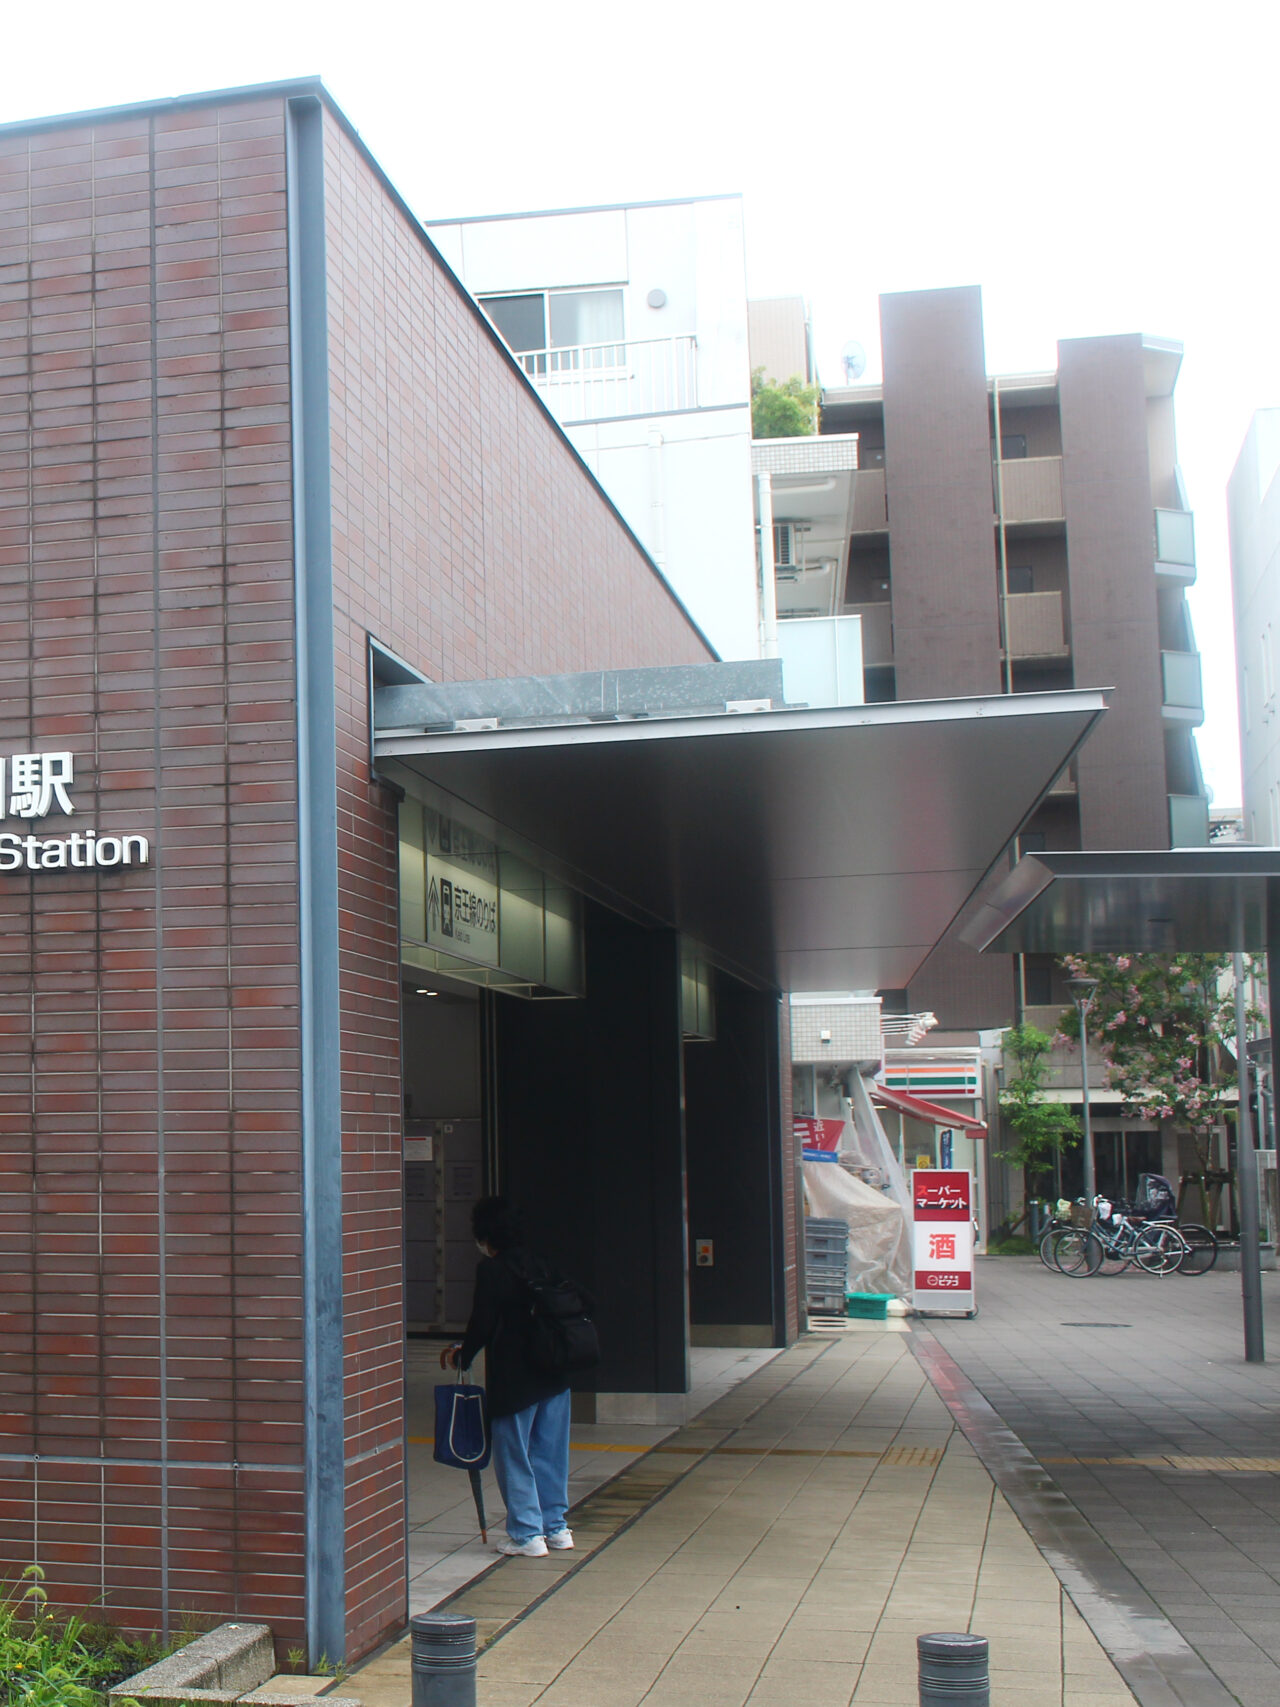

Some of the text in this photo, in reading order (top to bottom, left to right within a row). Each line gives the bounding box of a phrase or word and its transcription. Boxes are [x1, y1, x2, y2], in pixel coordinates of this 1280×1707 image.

[455, 886, 496, 933] 京王線のりば
[917, 1185, 961, 1196] スーパー
[916, 1197, 967, 1209] マーケット
[929, 1233, 956, 1260] 酒
